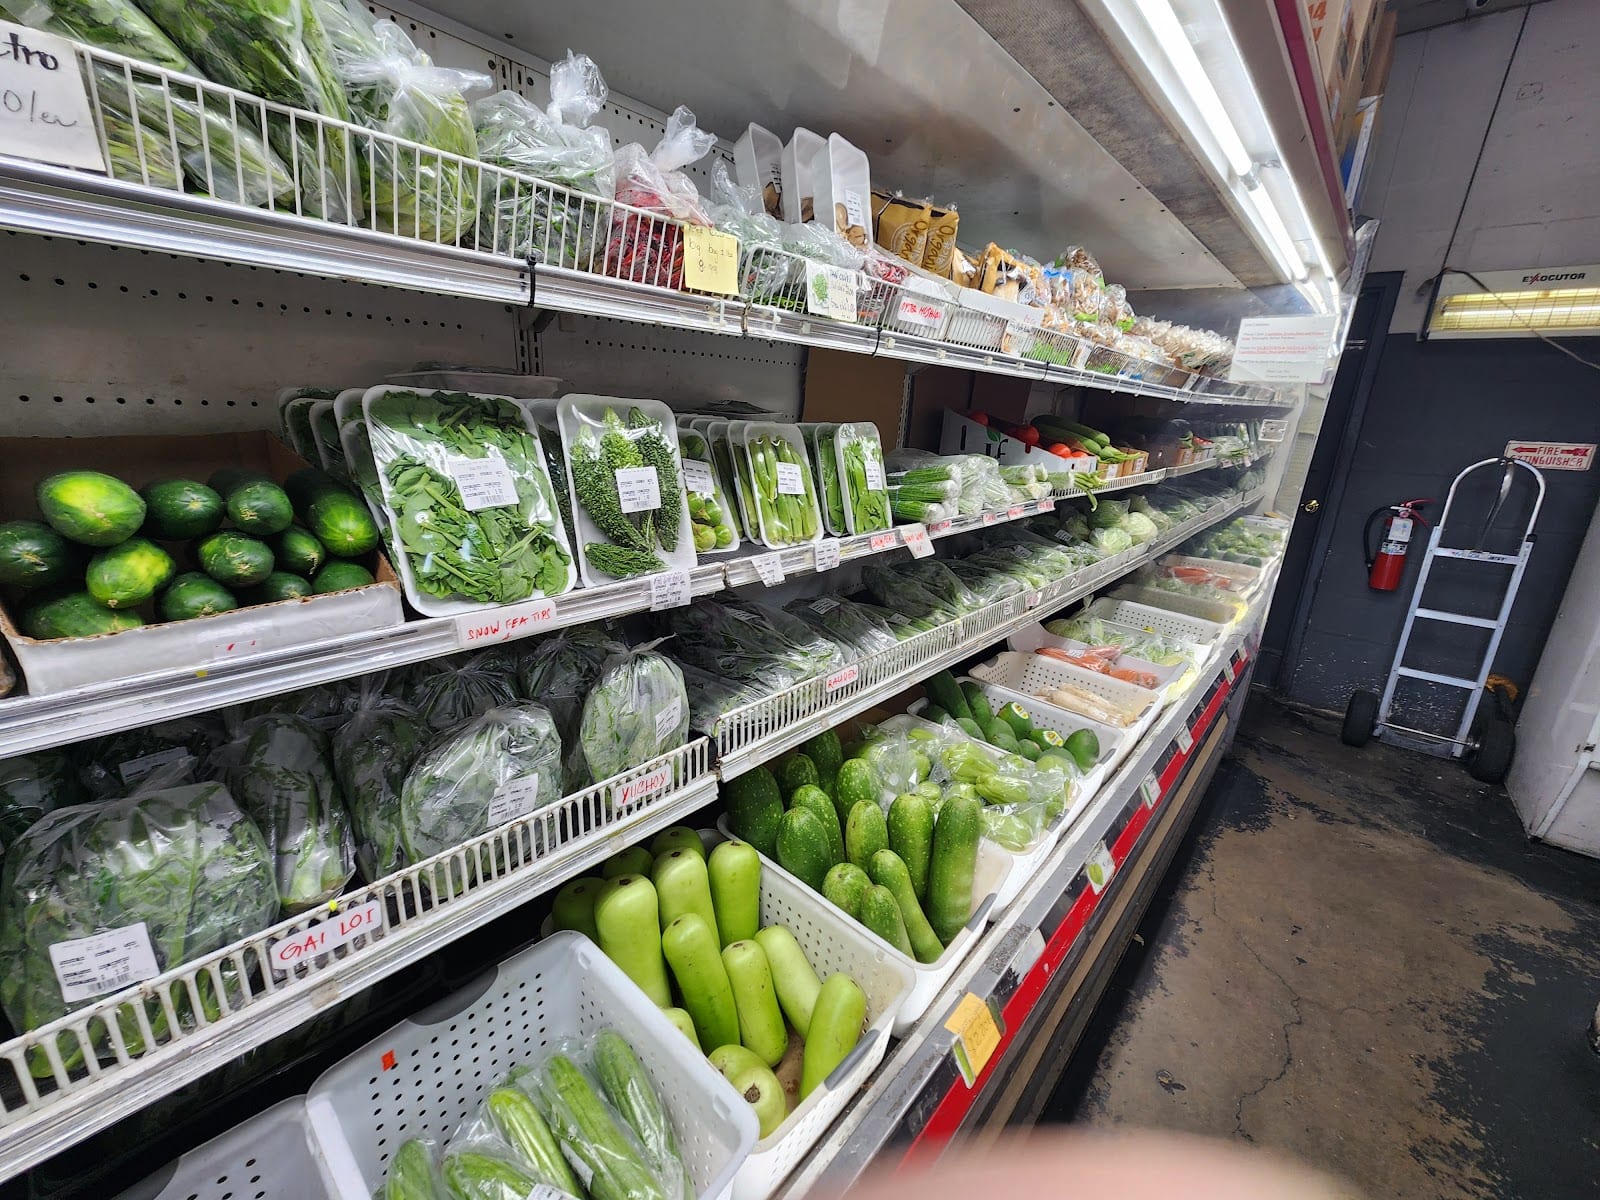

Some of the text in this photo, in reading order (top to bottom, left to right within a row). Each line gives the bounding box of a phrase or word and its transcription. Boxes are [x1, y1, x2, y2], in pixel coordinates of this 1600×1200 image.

[0, 32, 59, 71] tro
[1537, 446, 1560, 456] FIRE
[467, 620, 501, 640] SNOW
[280, 931, 326, 961] GAI
